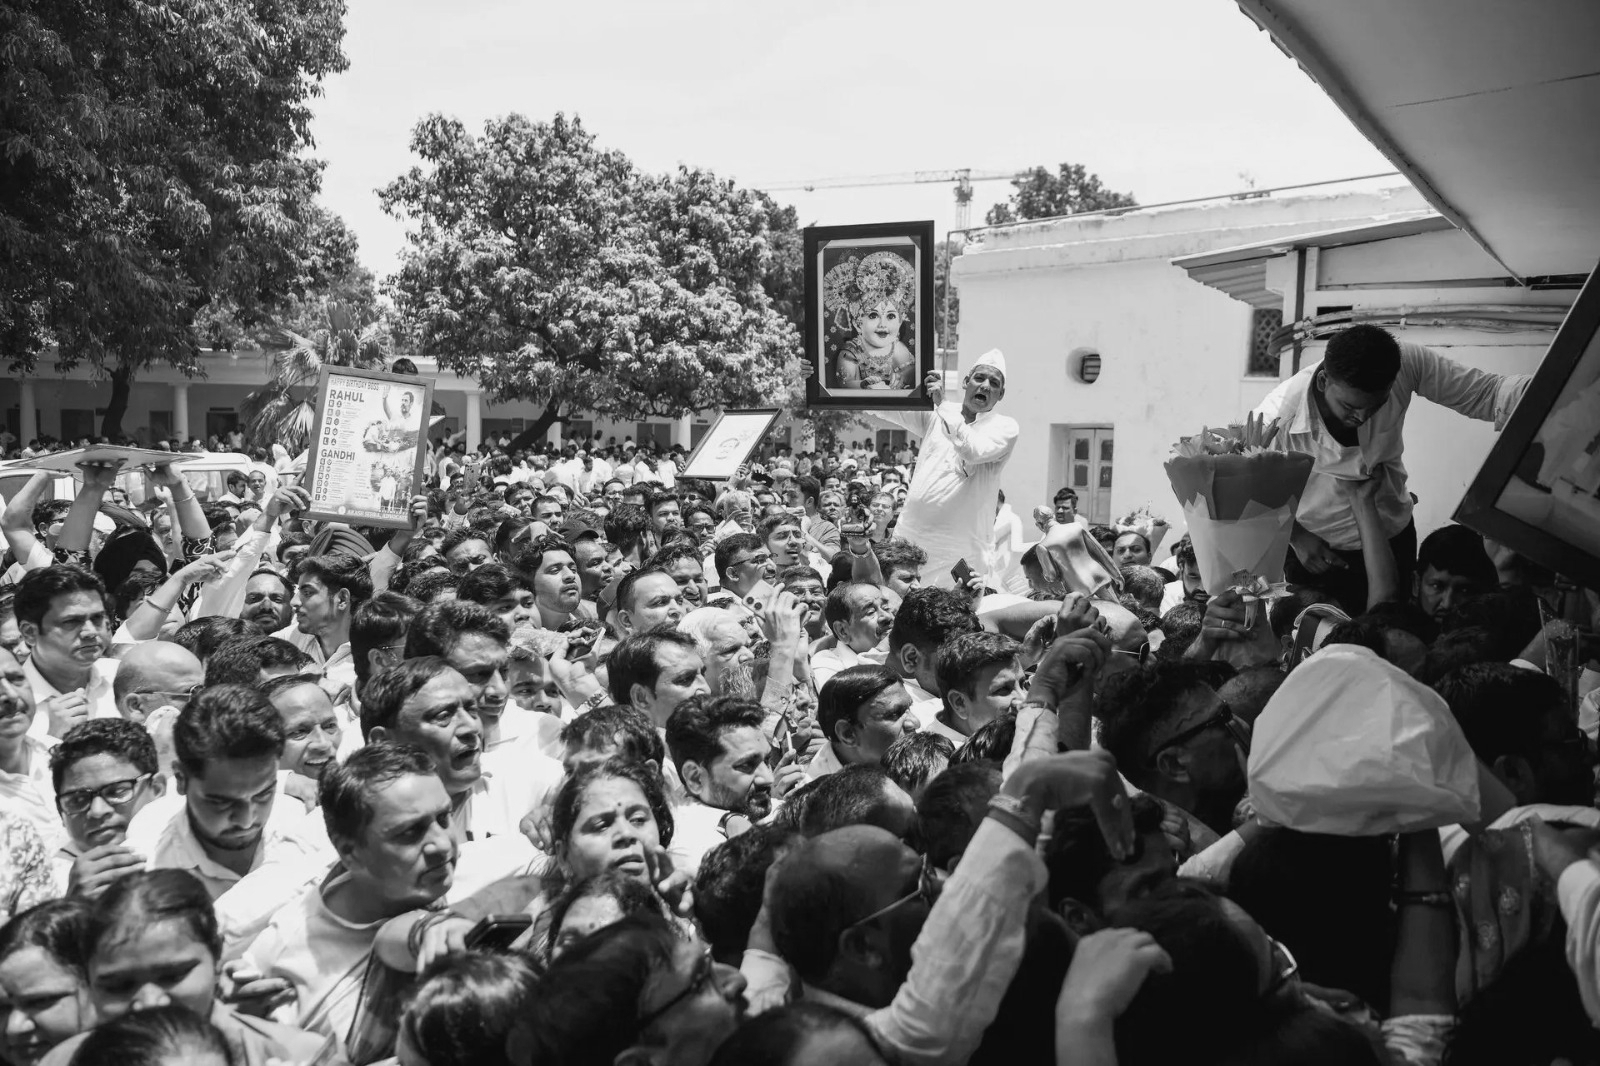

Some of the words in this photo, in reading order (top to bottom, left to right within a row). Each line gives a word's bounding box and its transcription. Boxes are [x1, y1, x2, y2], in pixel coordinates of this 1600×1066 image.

[331, 378, 346, 386] HAPPY
[346, 379, 367, 388] BIRTHDAY
[367, 382, 380, 390] BOSS
[330, 390, 364, 402] RAHUL
[321, 449, 355, 460] GANDHI
